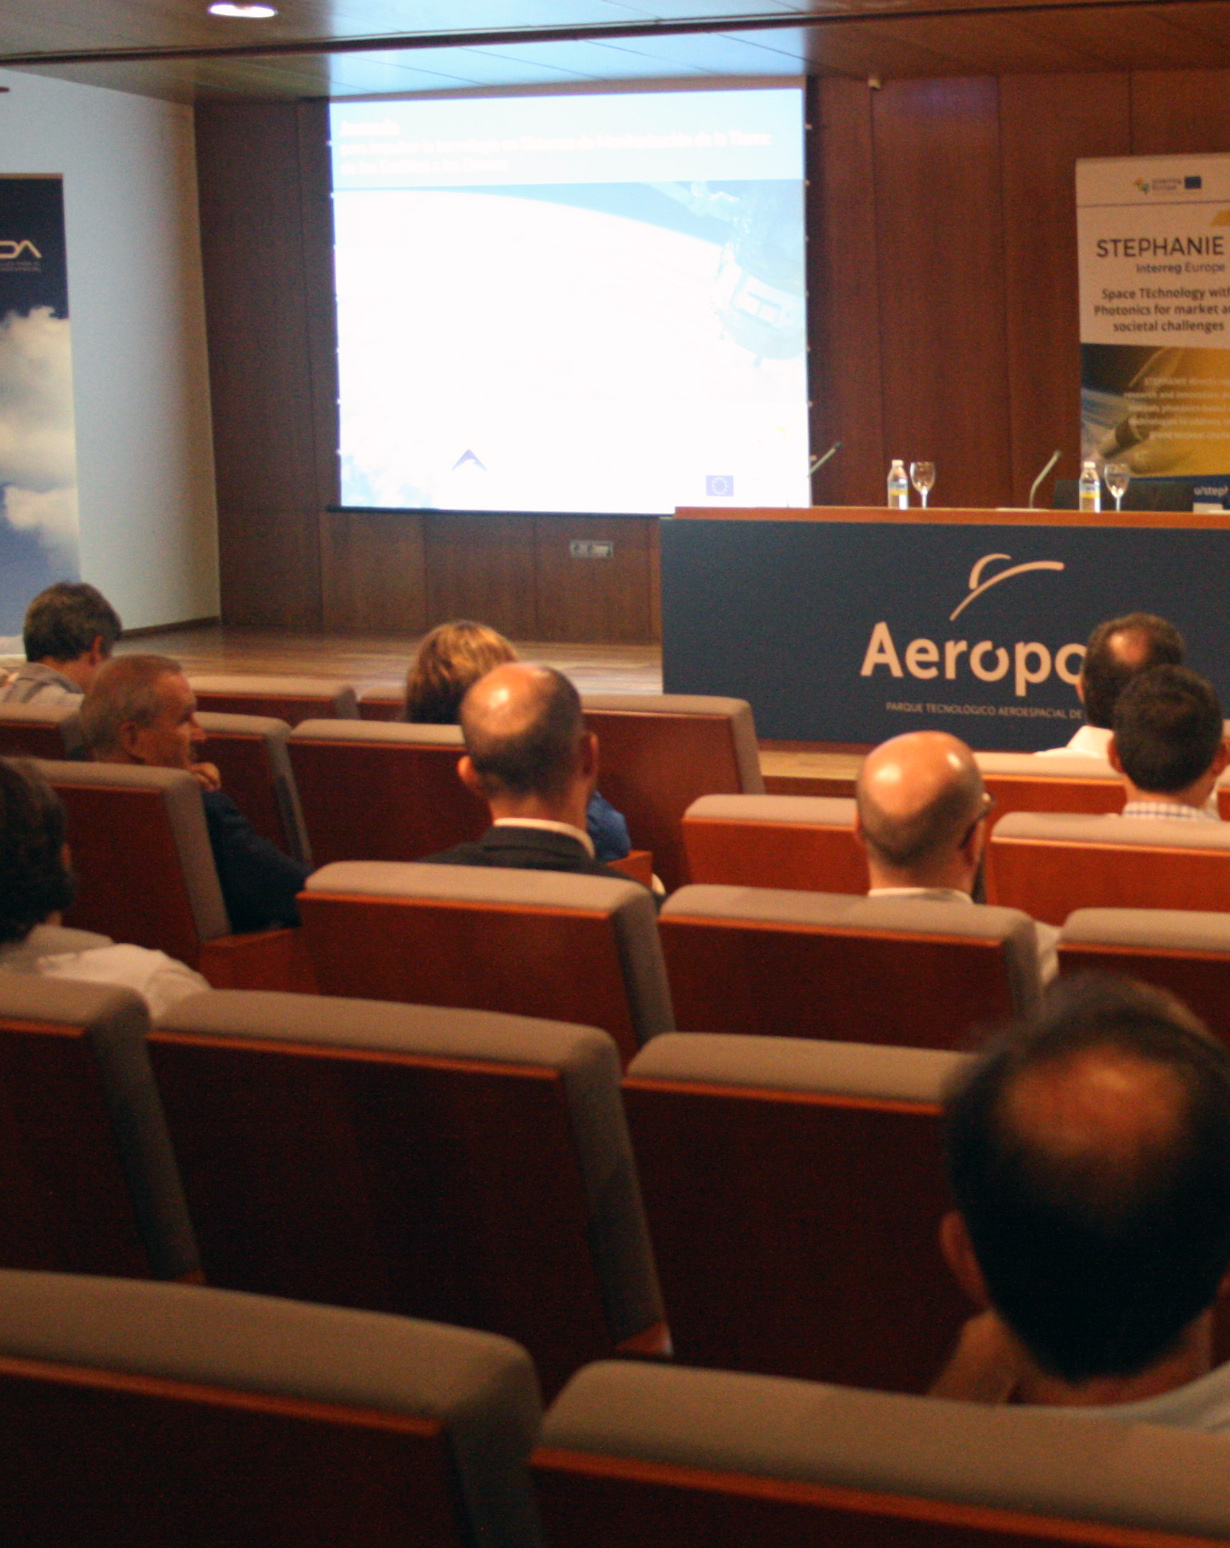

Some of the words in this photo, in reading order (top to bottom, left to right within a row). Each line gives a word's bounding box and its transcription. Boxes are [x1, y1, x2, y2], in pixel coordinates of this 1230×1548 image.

[1096, 236, 1225, 258] STEPHANIE
[1136, 264, 1182, 274] Interreg
[1184, 262, 1225, 273] Europe
[1102, 289, 1136, 301] Space
[1094, 304, 1150, 316] Photonics
[1154, 304, 1170, 315] for
[1174, 304, 1218, 315] market
[1113, 320, 1158, 332] societal
[1161, 320, 1224, 333] challenges
[886, 702, 923, 713] PARQUE
[998, 706, 1066, 719] AEROESPACIAL
[1069, 709, 1082, 719] DE
